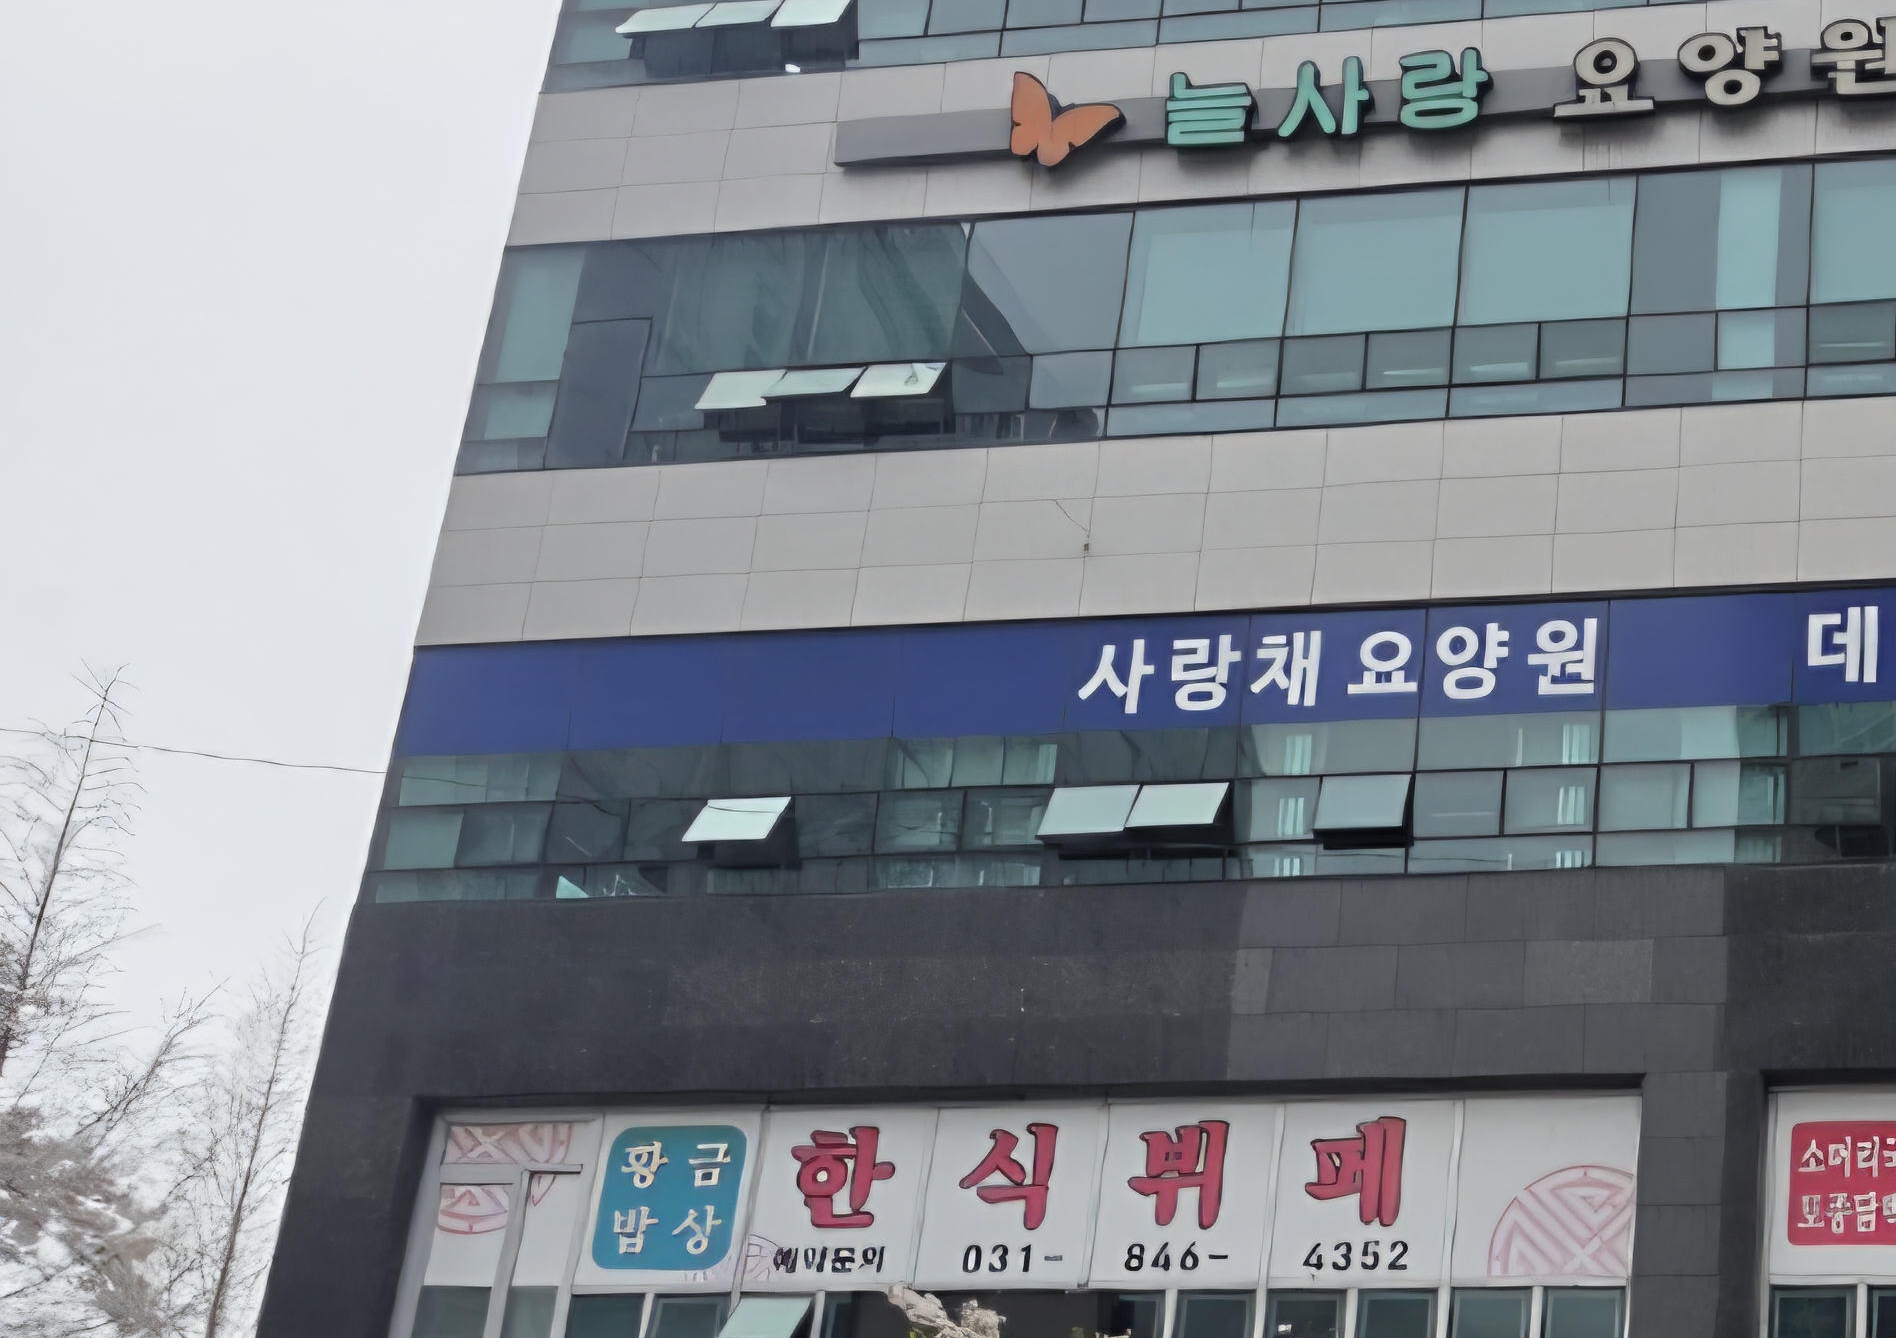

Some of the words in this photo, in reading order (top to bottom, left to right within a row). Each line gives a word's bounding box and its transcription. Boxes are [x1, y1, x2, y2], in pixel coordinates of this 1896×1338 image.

[1165, 46, 1489, 151] 늘사랑
[1077, 629, 1321, 716] 사랑채
[1345, 616, 1600, 701] 요양원
[622, 1140, 732, 1189] 황금
[613, 1205, 722, 1256] 밥상
